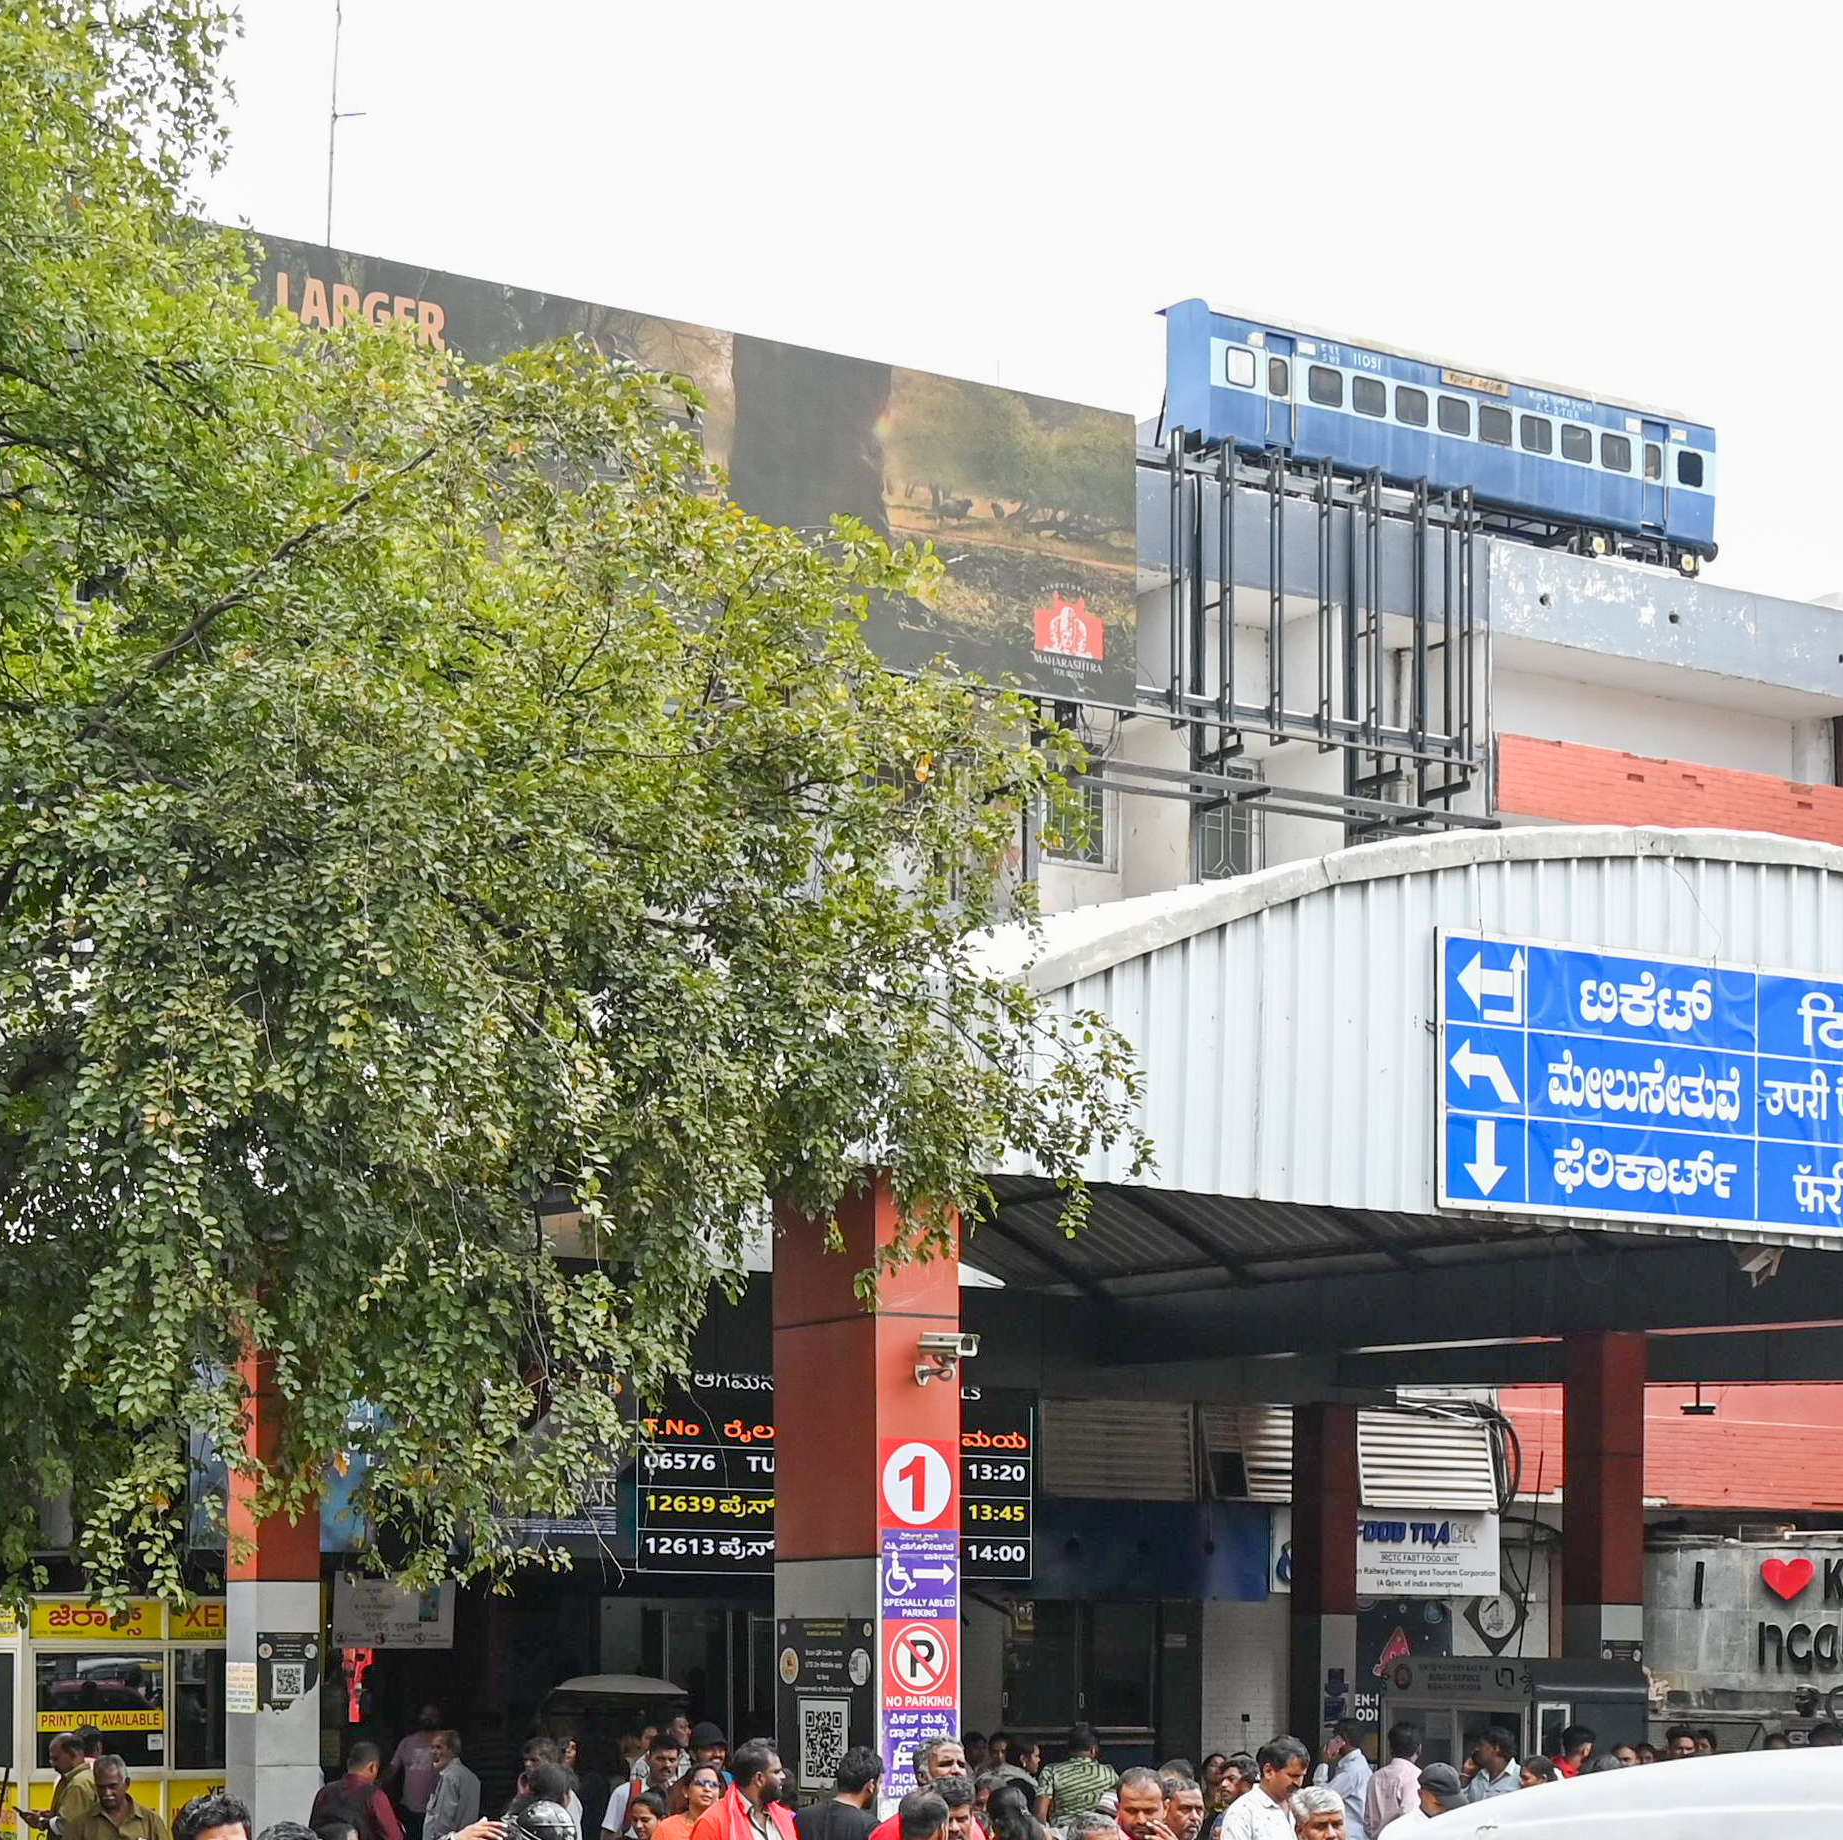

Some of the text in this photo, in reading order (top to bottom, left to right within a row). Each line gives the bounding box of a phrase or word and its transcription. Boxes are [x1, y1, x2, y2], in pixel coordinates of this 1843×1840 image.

[1031, 650, 1103, 675] MAHARASHTRA
[1580, 971, 1711, 1031] ಟಿಕೆಟ್
[1547, 1049, 1741, 1121] ಮೇಲುಸೇತುವೆ
[1763, 1069, 1830, 1120] उपरी
[643, 1453, 716, 1471] 06576
[968, 1463, 1026, 1481] 13:20
[898, 1456, 927, 1512] 1
[645, 1495, 716, 1513] 12639
[968, 1504, 1025, 1521] 13:45
[645, 1537, 716, 1555] 12613
[968, 1544, 1026, 1562] 14:00
[1381, 1553, 1458, 1563] IRCTC FAST FOOD UNIT
[1390, 1568, 1417, 1578] Catering
[1419, 1569, 1431, 1577] and
[1432, 1569, 1457, 1577] Tourism
[1459, 1569, 1497, 1579] Corporation
[1694, 1561, 1705, 1608] I
[884, 1598, 955, 1608] SPECIALLY ABLED
[185, 1605, 226, 1628] XE
[902, 1609, 938, 1617] PARKING
[885, 1695, 953, 1707] NO PARKING
[41, 1712, 160, 1727] PRINT OUT AVAILABLE
